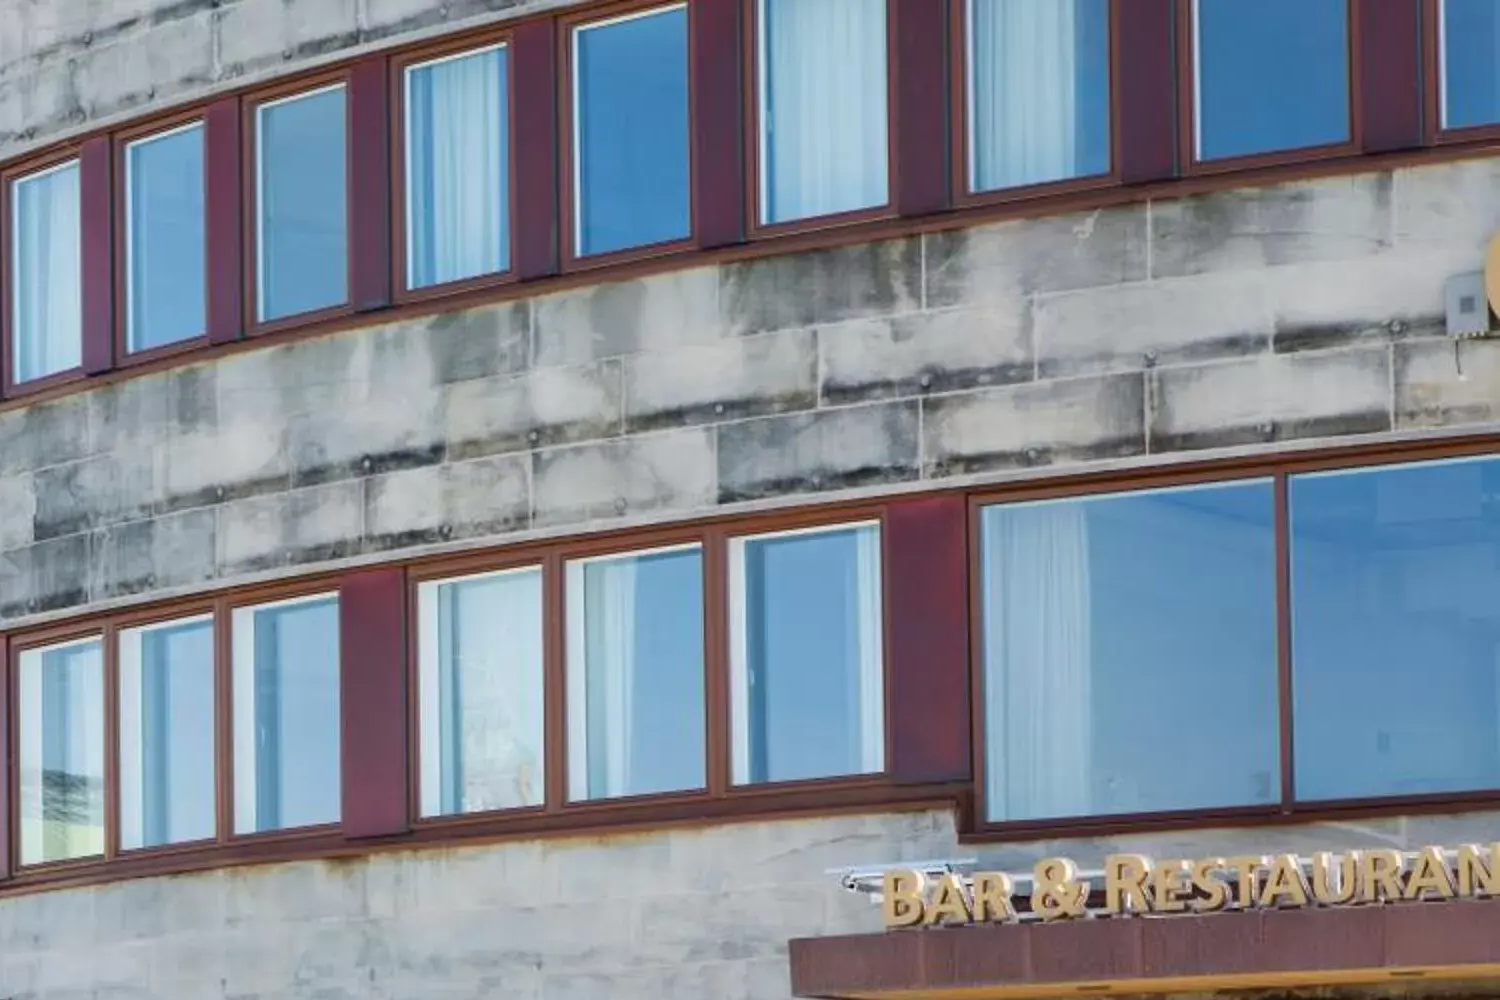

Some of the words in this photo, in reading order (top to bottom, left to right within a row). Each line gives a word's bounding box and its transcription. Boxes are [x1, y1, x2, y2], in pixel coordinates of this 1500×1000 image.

[882, 867, 1014, 927] BAR
[1030, 857, 1090, 922] &
[1105, 841, 1500, 917] RESTAURAN
